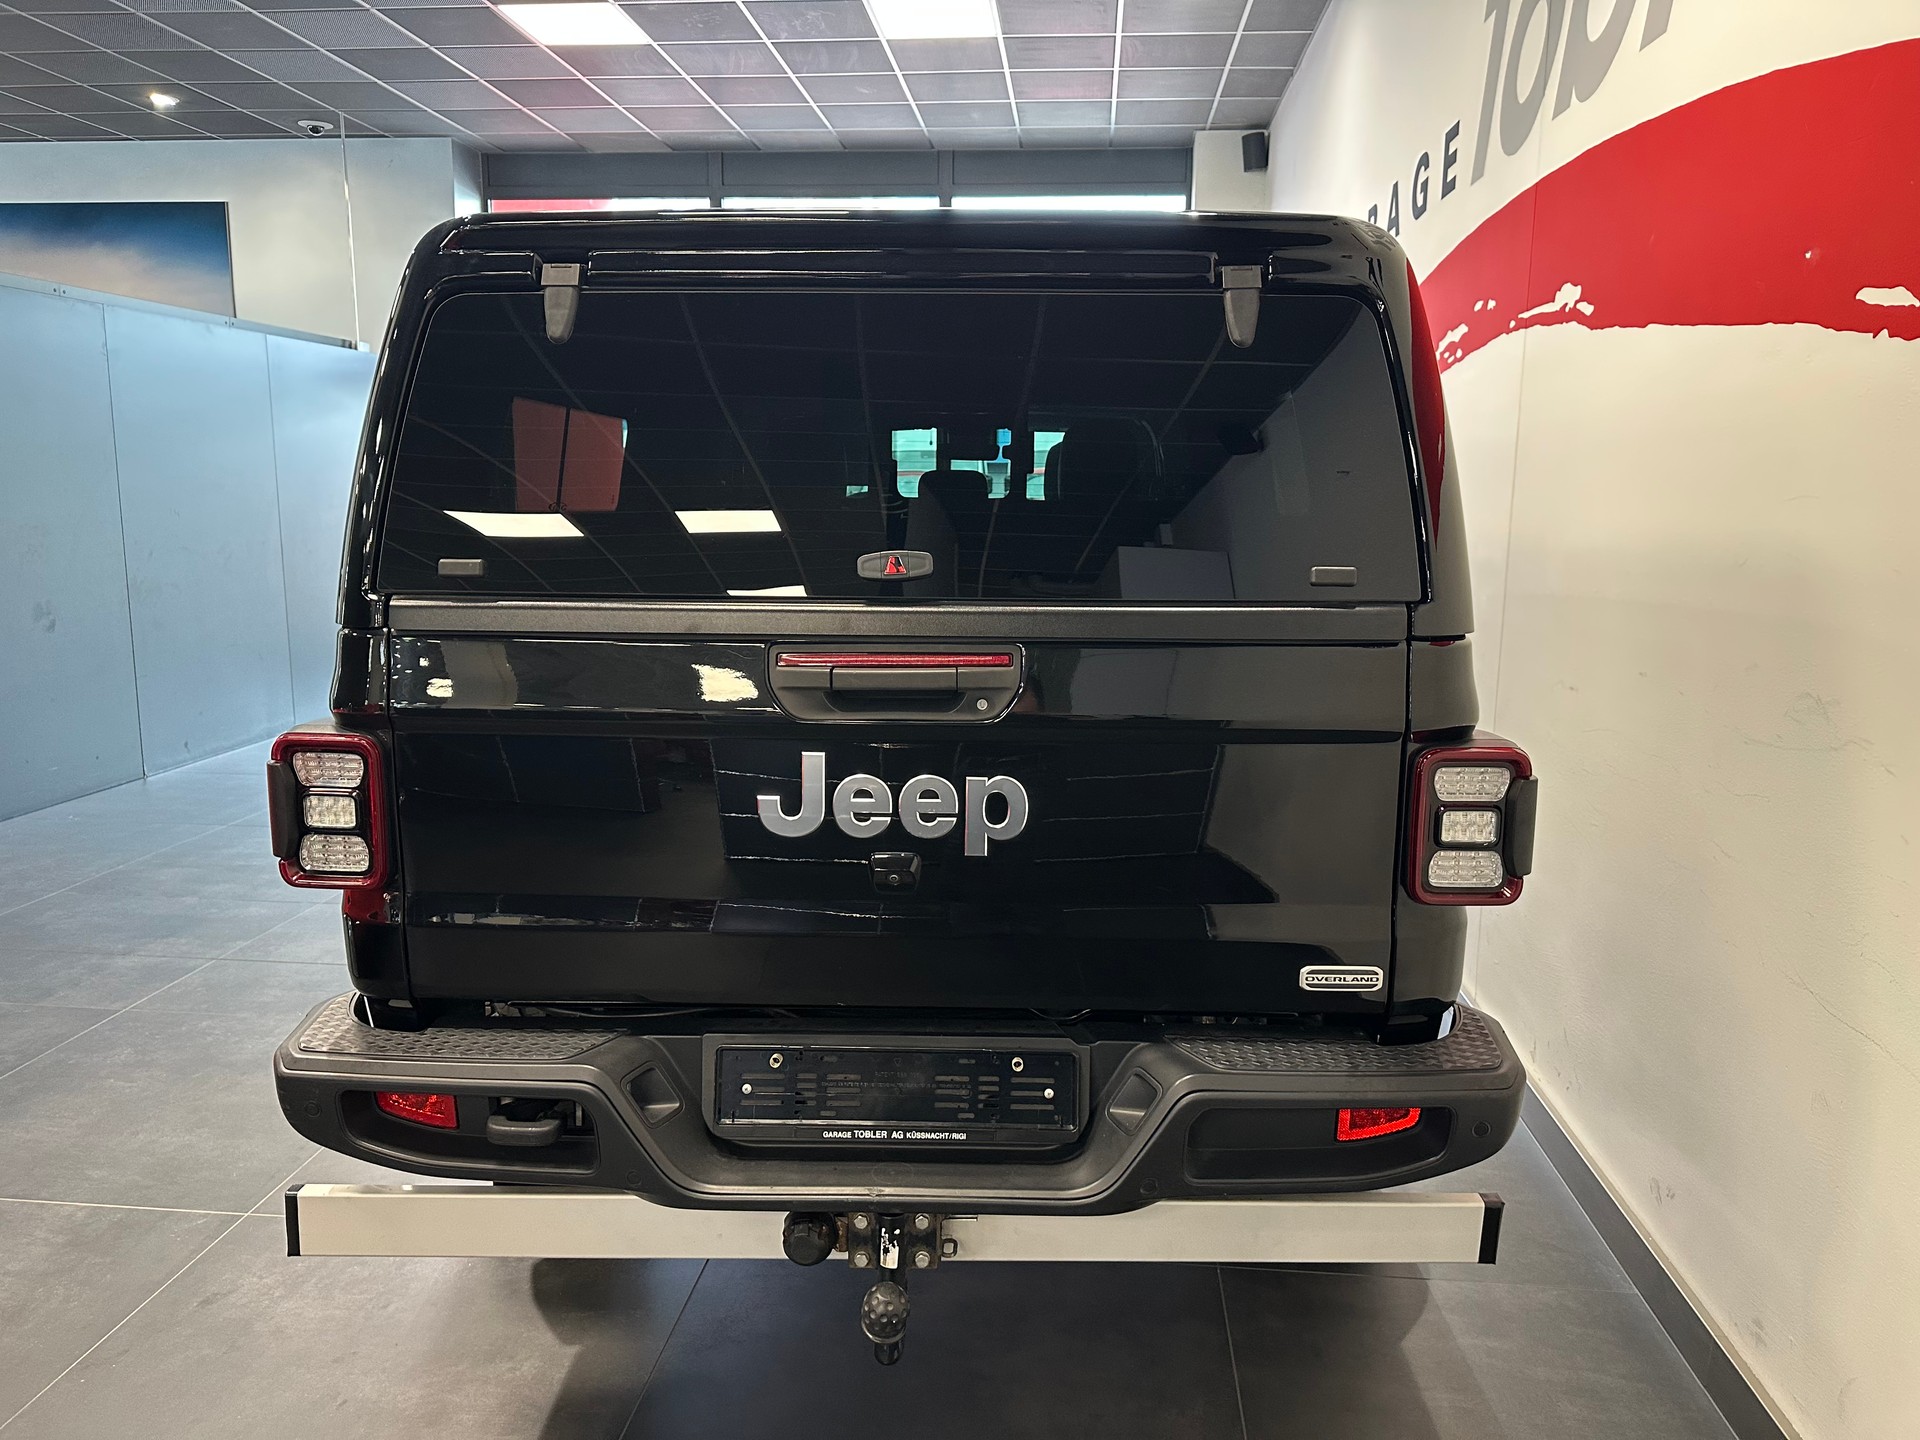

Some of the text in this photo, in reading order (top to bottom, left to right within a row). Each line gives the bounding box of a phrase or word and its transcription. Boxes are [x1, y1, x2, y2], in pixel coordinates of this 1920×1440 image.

[757, 752, 1029, 857] Jeep
[822, 1129, 967, 1140] GARAGE TOBLER AG KÜSSNACHT/RIGI
